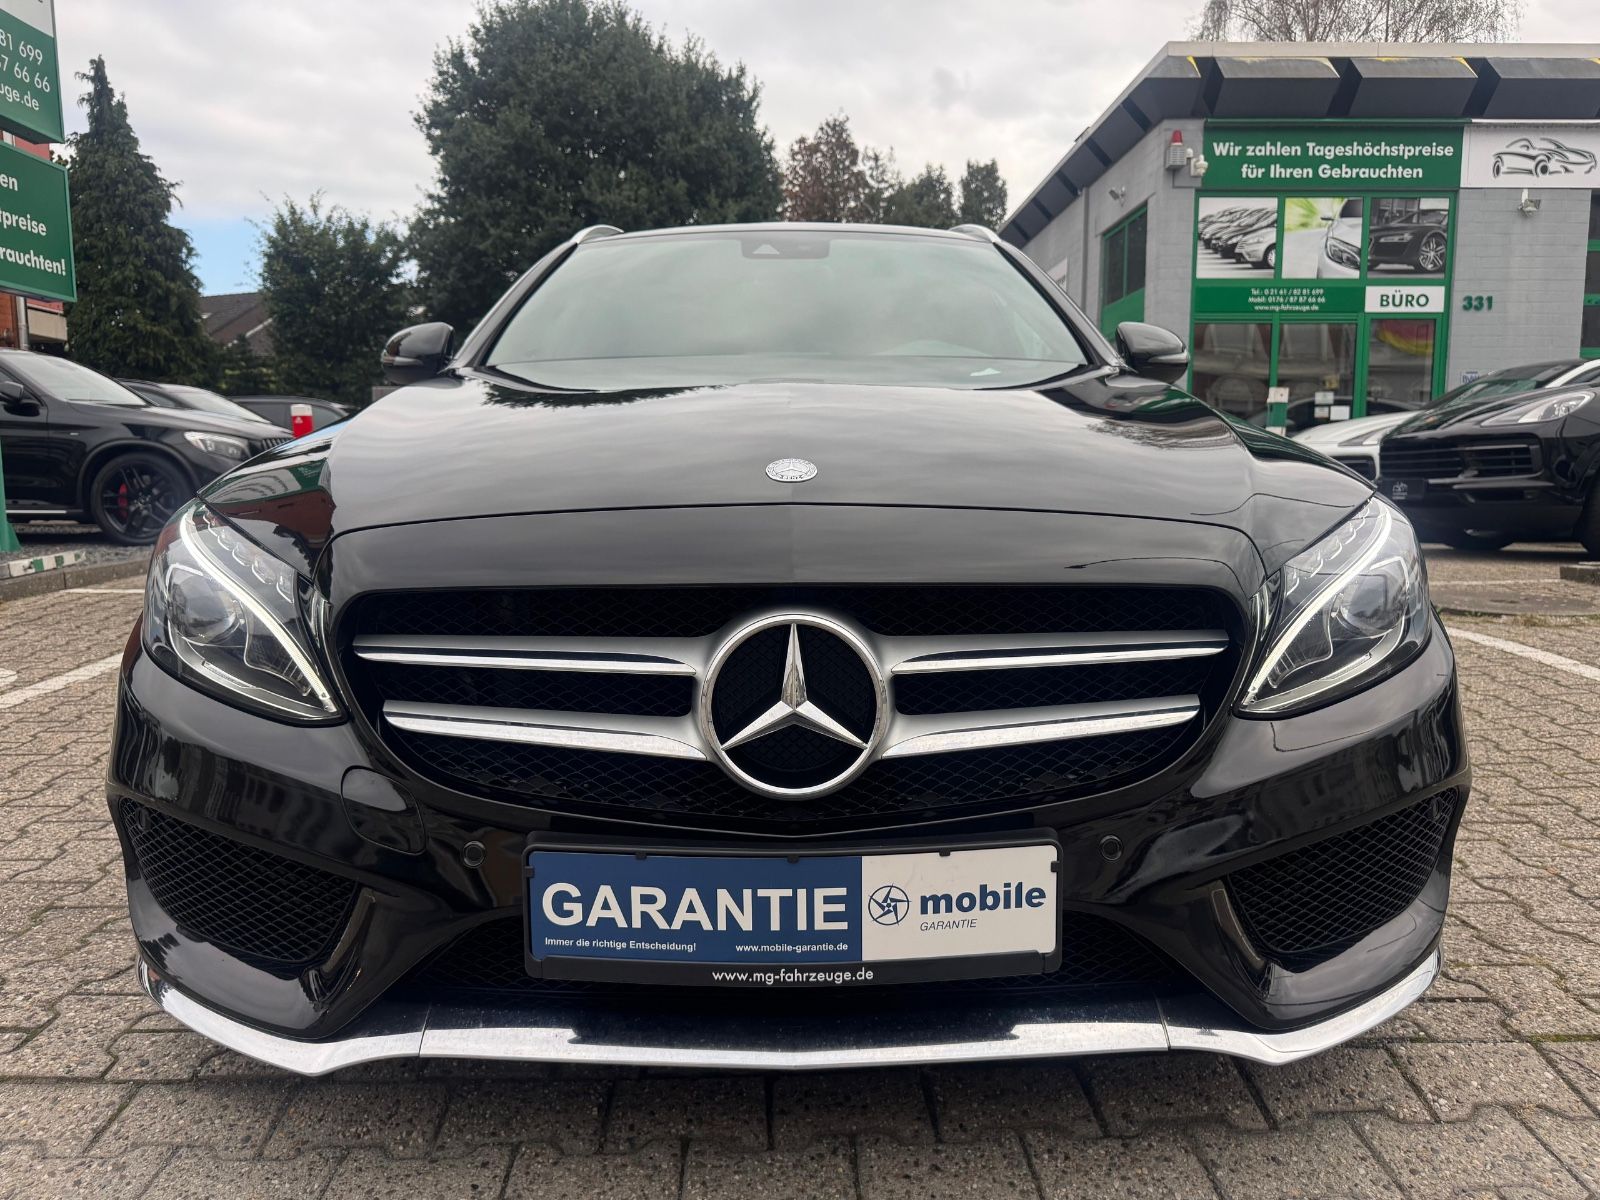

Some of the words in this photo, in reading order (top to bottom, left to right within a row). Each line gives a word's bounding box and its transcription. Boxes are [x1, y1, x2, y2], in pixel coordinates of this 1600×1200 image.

[19, 40, 43, 66] 699
[0, 54, 9, 72] 7
[14, 61, 30, 83] 66
[34, 72, 51, 93] 66
[1212, 142, 1241, 157] Wir
[1246, 142, 1301, 157] zahlen
[1306, 142, 1454, 160] Tageshöchstpreise
[1241, 164, 1265, 178] für
[1270, 164, 1313, 178] Ihren
[1318, 164, 1423, 178] Gebrauchten
[0, 208, 47, 236] preise
[1379, 289, 1430, 308] BÜRO
[1462, 295, 1494, 311] 331
[542, 882, 849, 932] GARANTIE
[920, 881, 1047, 915] mobile
[920, 918, 978, 932] GARANTIE
[544, 937, 574, 946] Immer
[576, 939, 590, 947] die
[592, 939, 627, 950] richtige
[629, 940, 697, 953] Entscheidung!
[735, 942, 849, 954] www.mobile-garantie.de
[711, 967, 874, 985] www.mg-fahrzeuge.de
